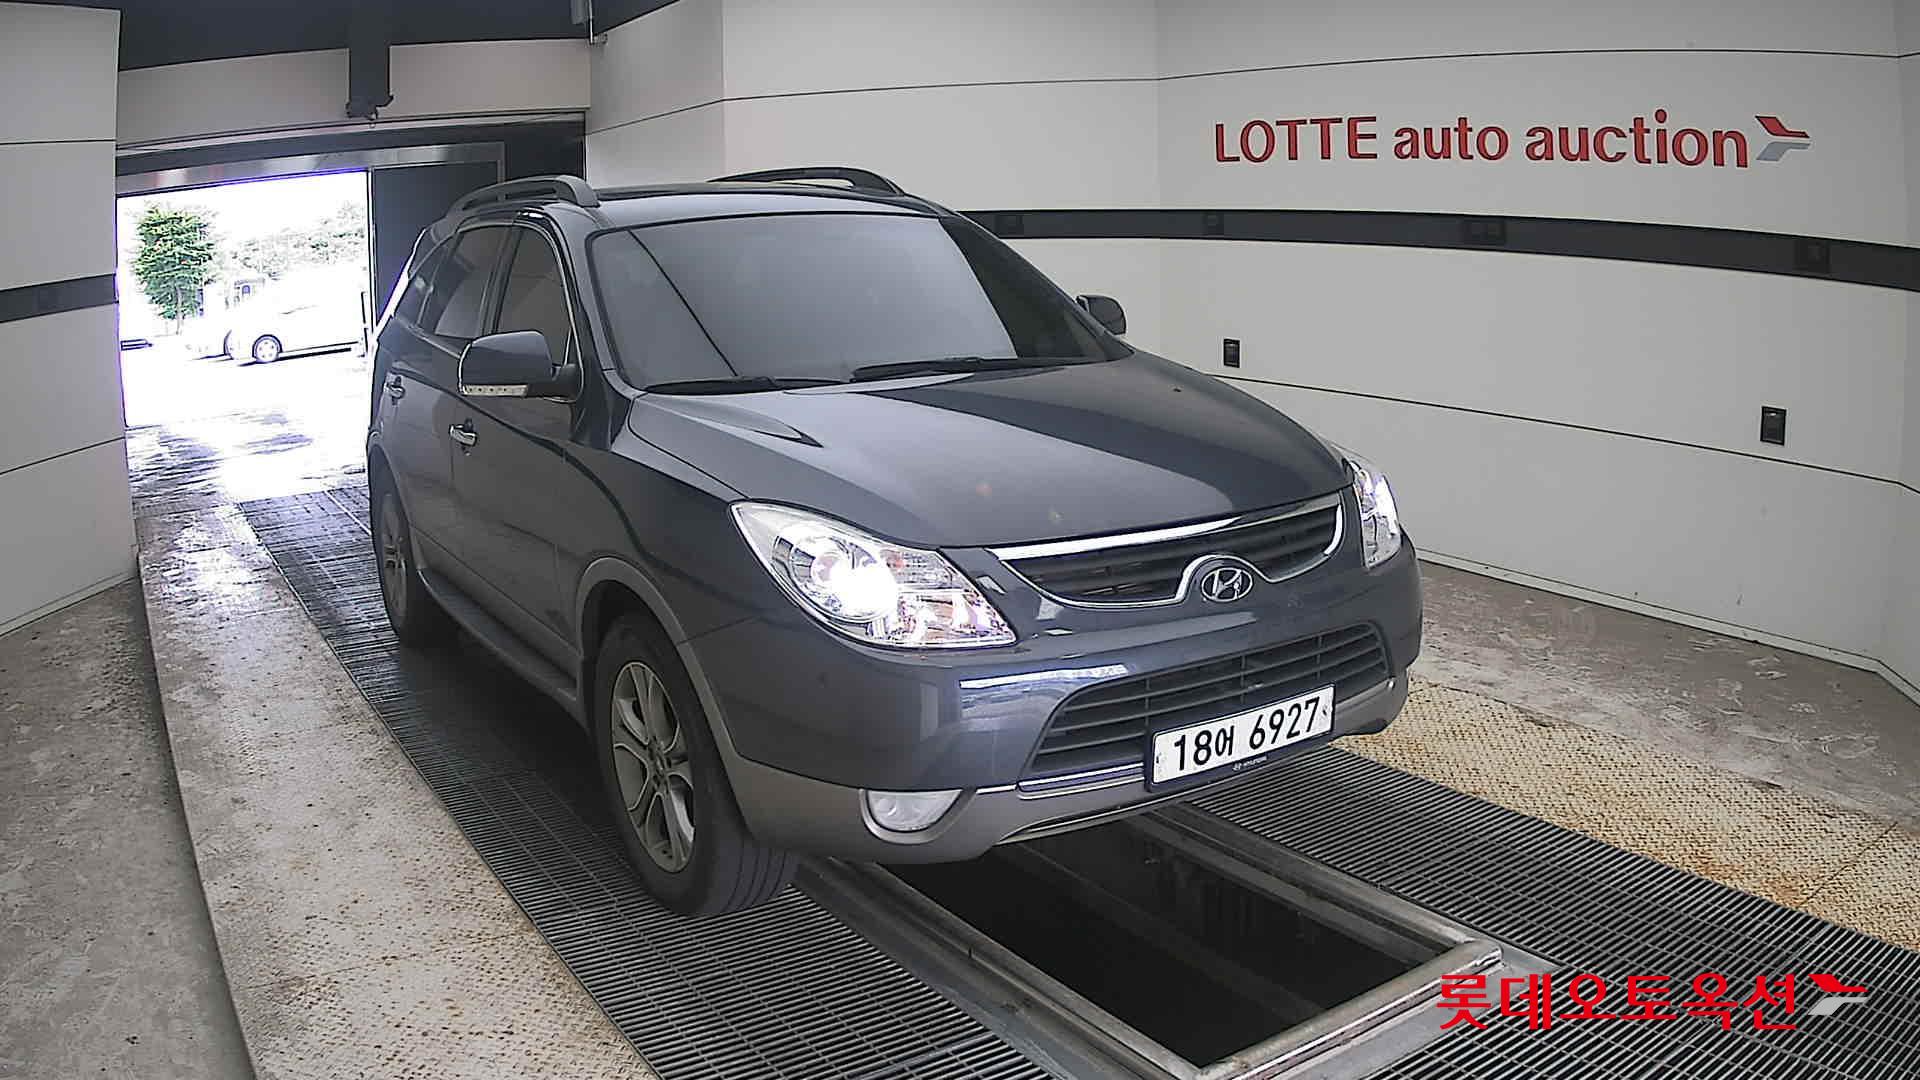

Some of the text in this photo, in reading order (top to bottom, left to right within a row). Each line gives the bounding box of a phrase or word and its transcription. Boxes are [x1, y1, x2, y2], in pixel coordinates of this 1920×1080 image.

[1215, 109, 1750, 168] LOTTE auto auction
[1174, 696, 1321, 771] 18어 6927
